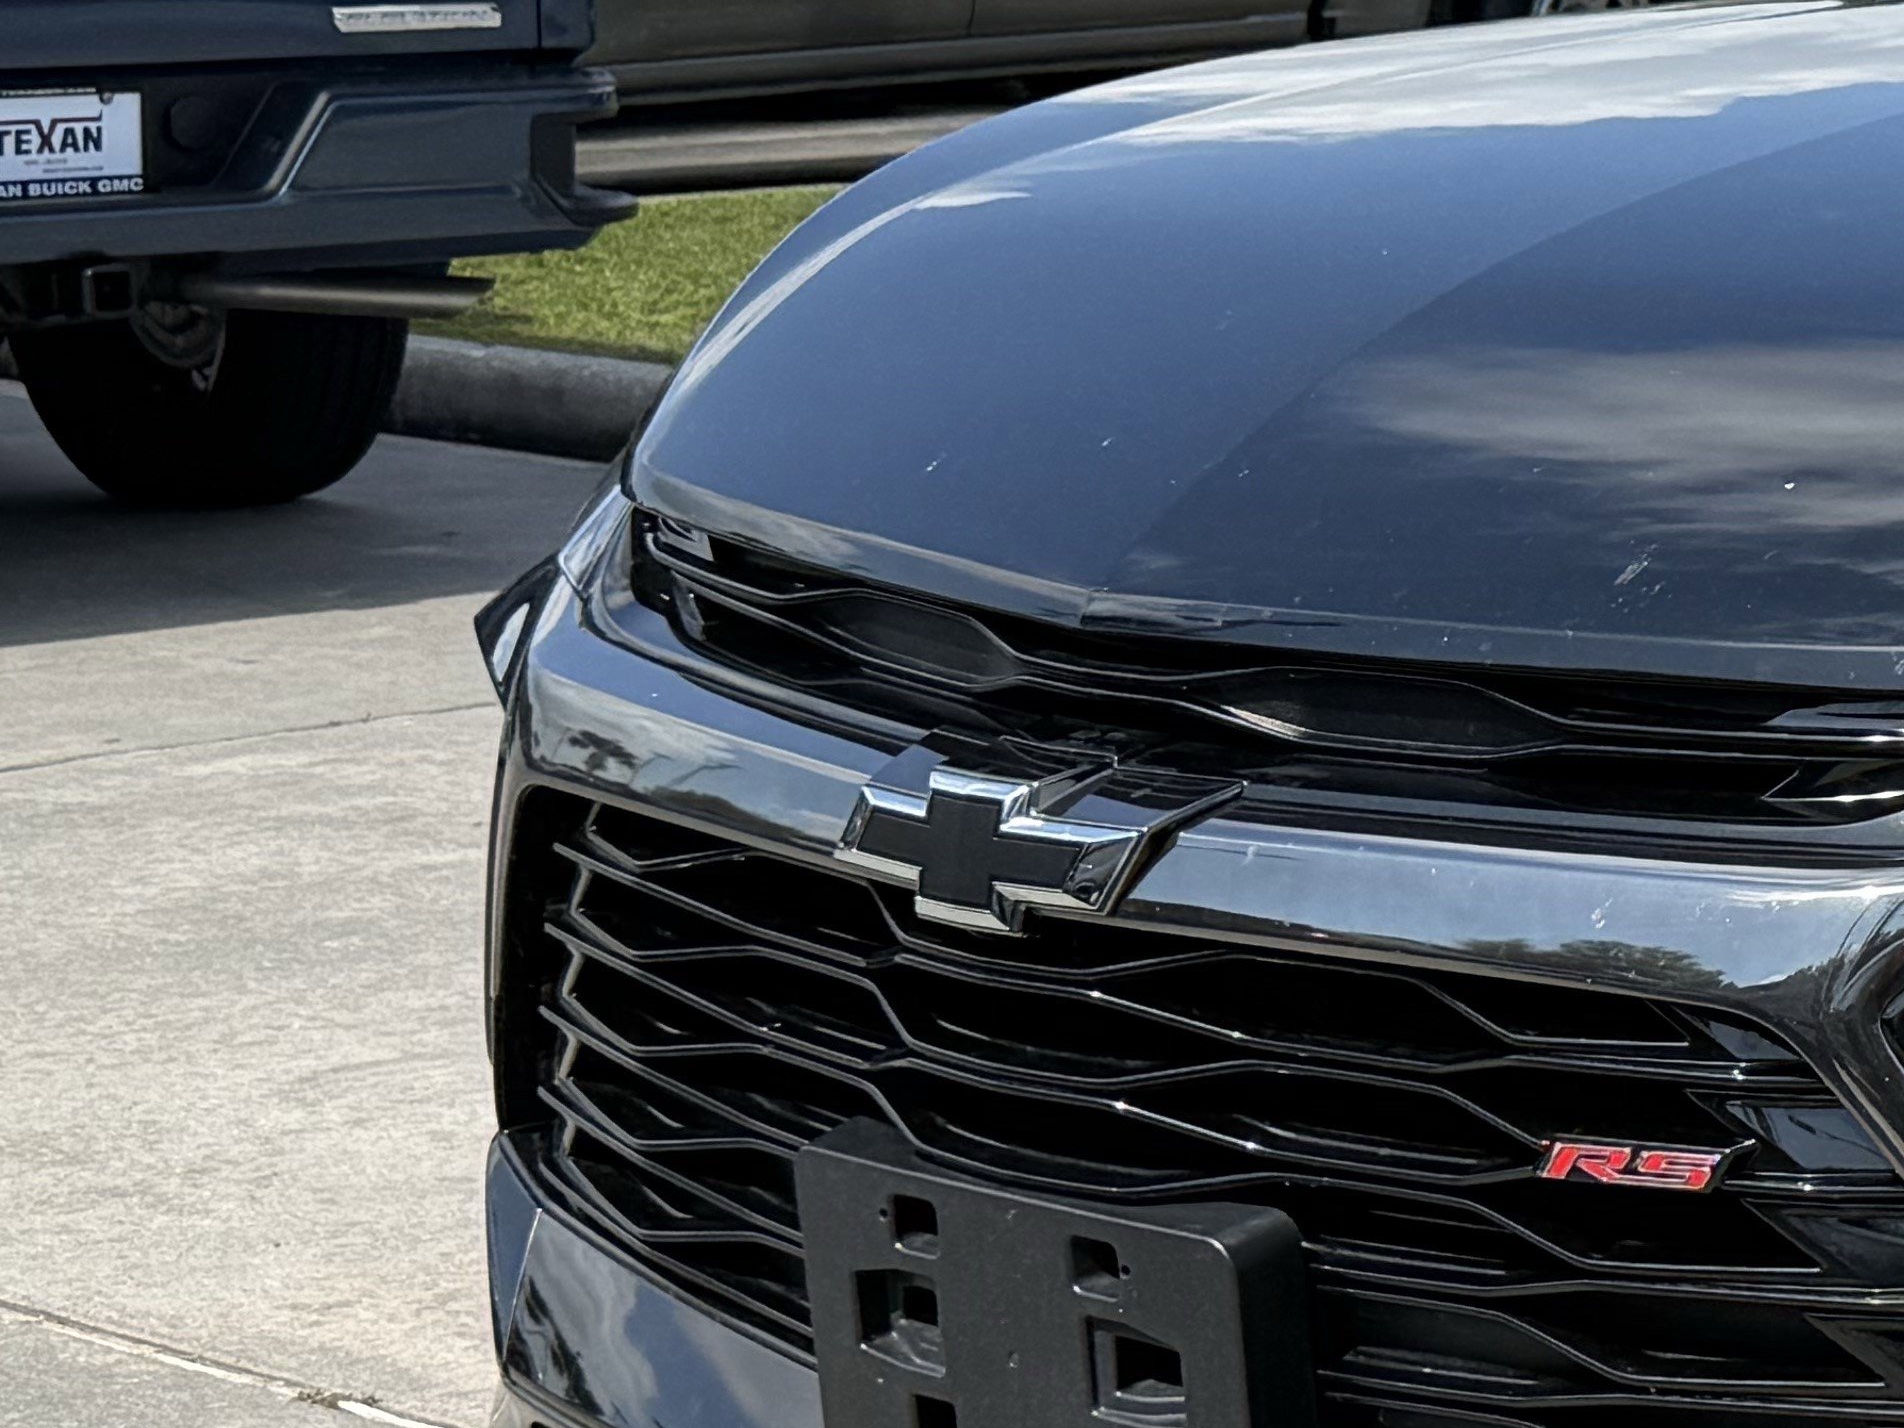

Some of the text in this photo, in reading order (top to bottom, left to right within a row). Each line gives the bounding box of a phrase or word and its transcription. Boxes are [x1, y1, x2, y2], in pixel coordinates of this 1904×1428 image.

[27, 179, 93, 197] BUICK
[97, 176, 145, 193] GMC
[1540, 1141, 1722, 1191] RS
